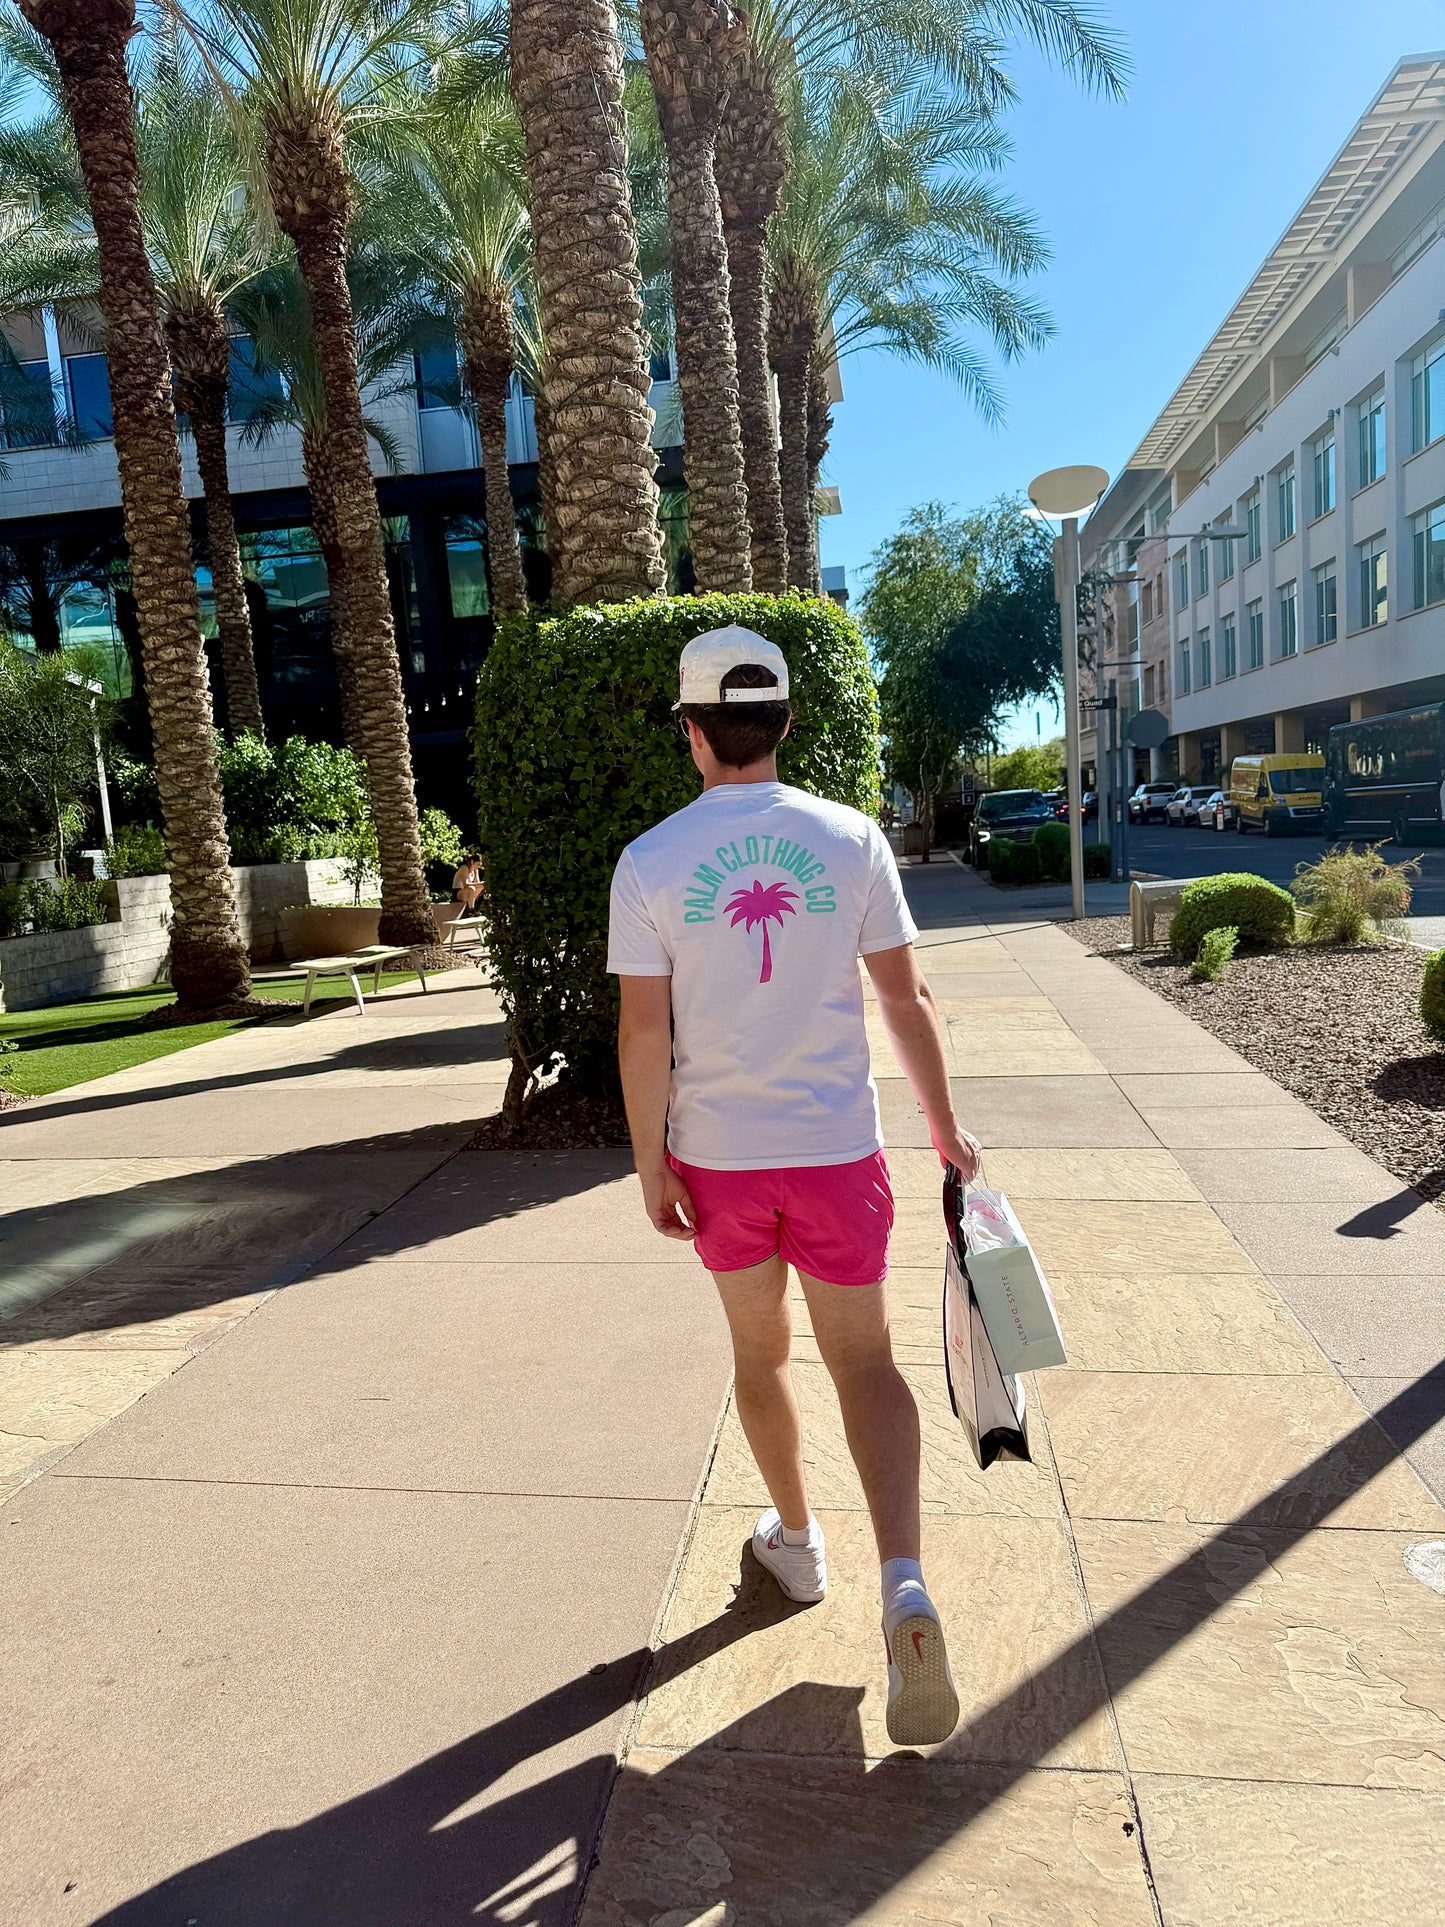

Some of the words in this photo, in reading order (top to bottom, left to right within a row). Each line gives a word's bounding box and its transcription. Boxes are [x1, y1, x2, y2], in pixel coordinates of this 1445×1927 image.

[1084, 699, 1103, 707] Quad
[683, 863, 726, 924] PALM
[715, 835, 826, 885] CLOTHING
[804, 885, 837, 914] CO
[1002, 1275, 1015, 1304] STATE
